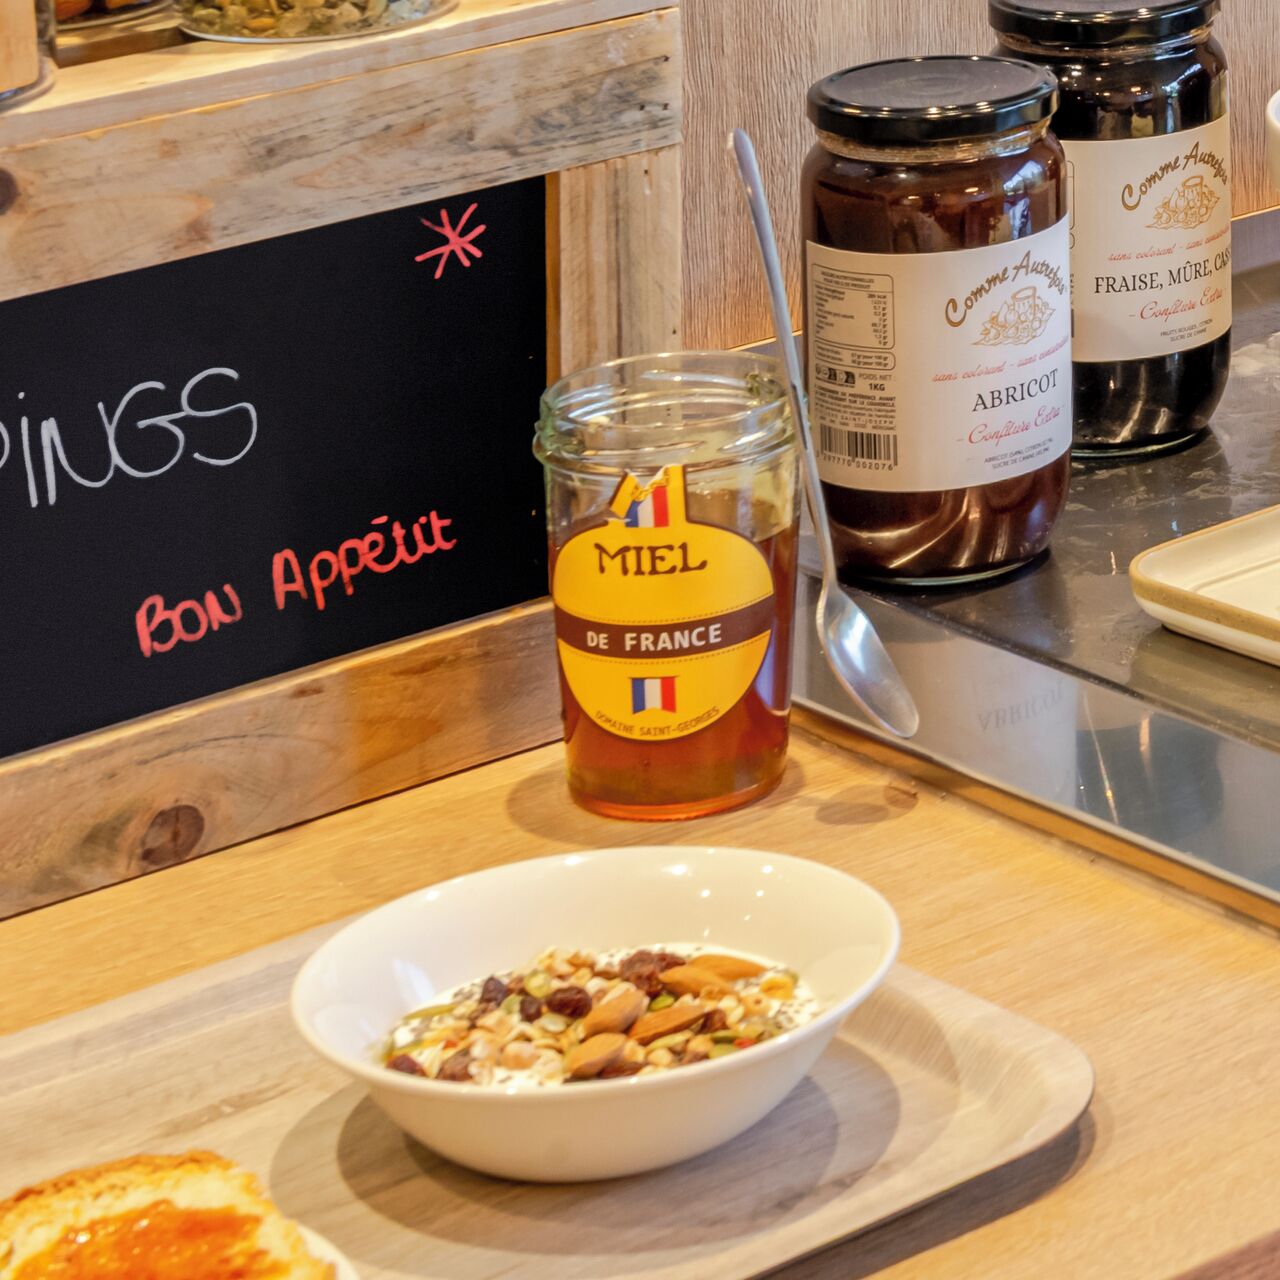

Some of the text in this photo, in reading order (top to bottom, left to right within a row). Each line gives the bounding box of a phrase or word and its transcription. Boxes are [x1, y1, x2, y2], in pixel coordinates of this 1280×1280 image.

[1121, 155, 1181, 211] Comme
[1094, 271, 1164, 294] FRAISE,
[1168, 260, 1213, 287] MÛRE,
[945, 266, 1009, 328] Comme
[868, 382, 886, 392] 1KG
[971, 367, 1059, 412] ABRICOT
[855, 460, 894, 472] 002076
[272, 510, 458, 611] Appétit
[594, 542, 708, 576] MIEL
[586, 623, 723, 652] DE FRANCE
